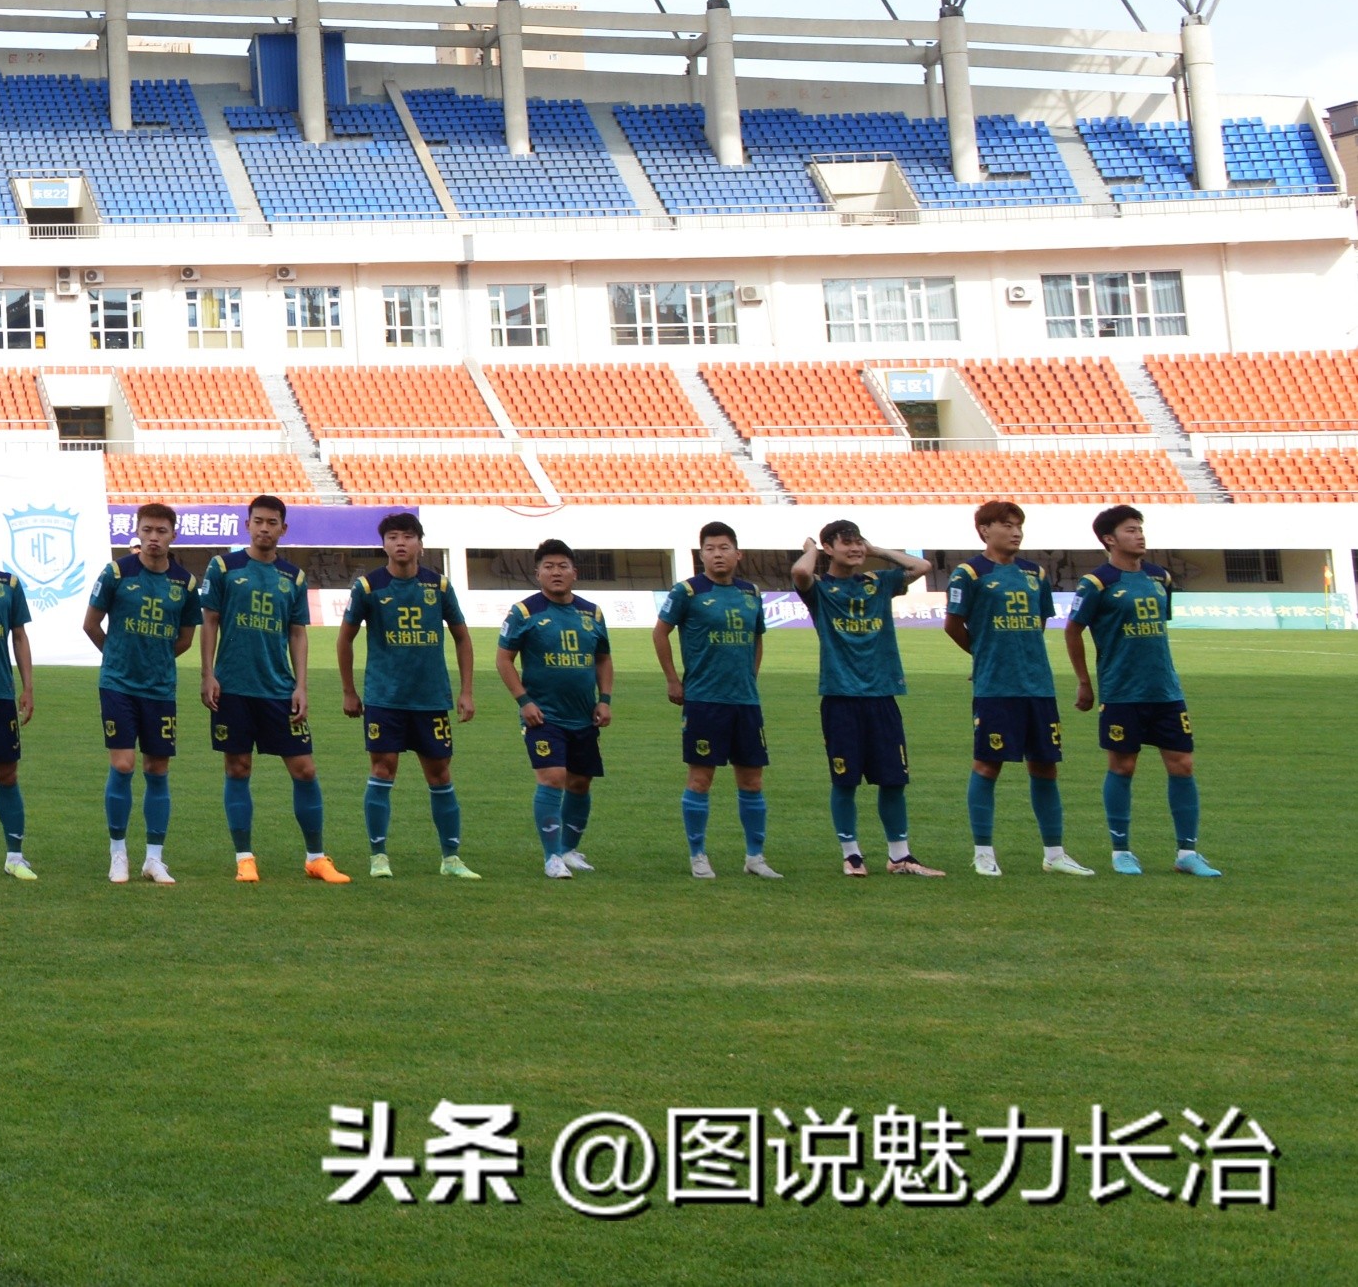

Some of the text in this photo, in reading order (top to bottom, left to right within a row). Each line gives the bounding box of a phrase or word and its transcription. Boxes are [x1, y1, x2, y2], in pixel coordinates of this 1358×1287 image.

[891, 378, 932, 393] 东区1
[175, 513, 239, 536] 想起航
[141, 596, 164, 620] 26
[251, 590, 274, 614] 66
[850, 598, 865, 617] 11
[1004, 591, 1029, 614] 29
[1134, 597, 1158, 620] 69
[397, 606, 422, 629] 22
[725, 609, 744, 630] 16
[386, 630, 438, 645] 长治汇承
[560, 630, 579, 652] 10
